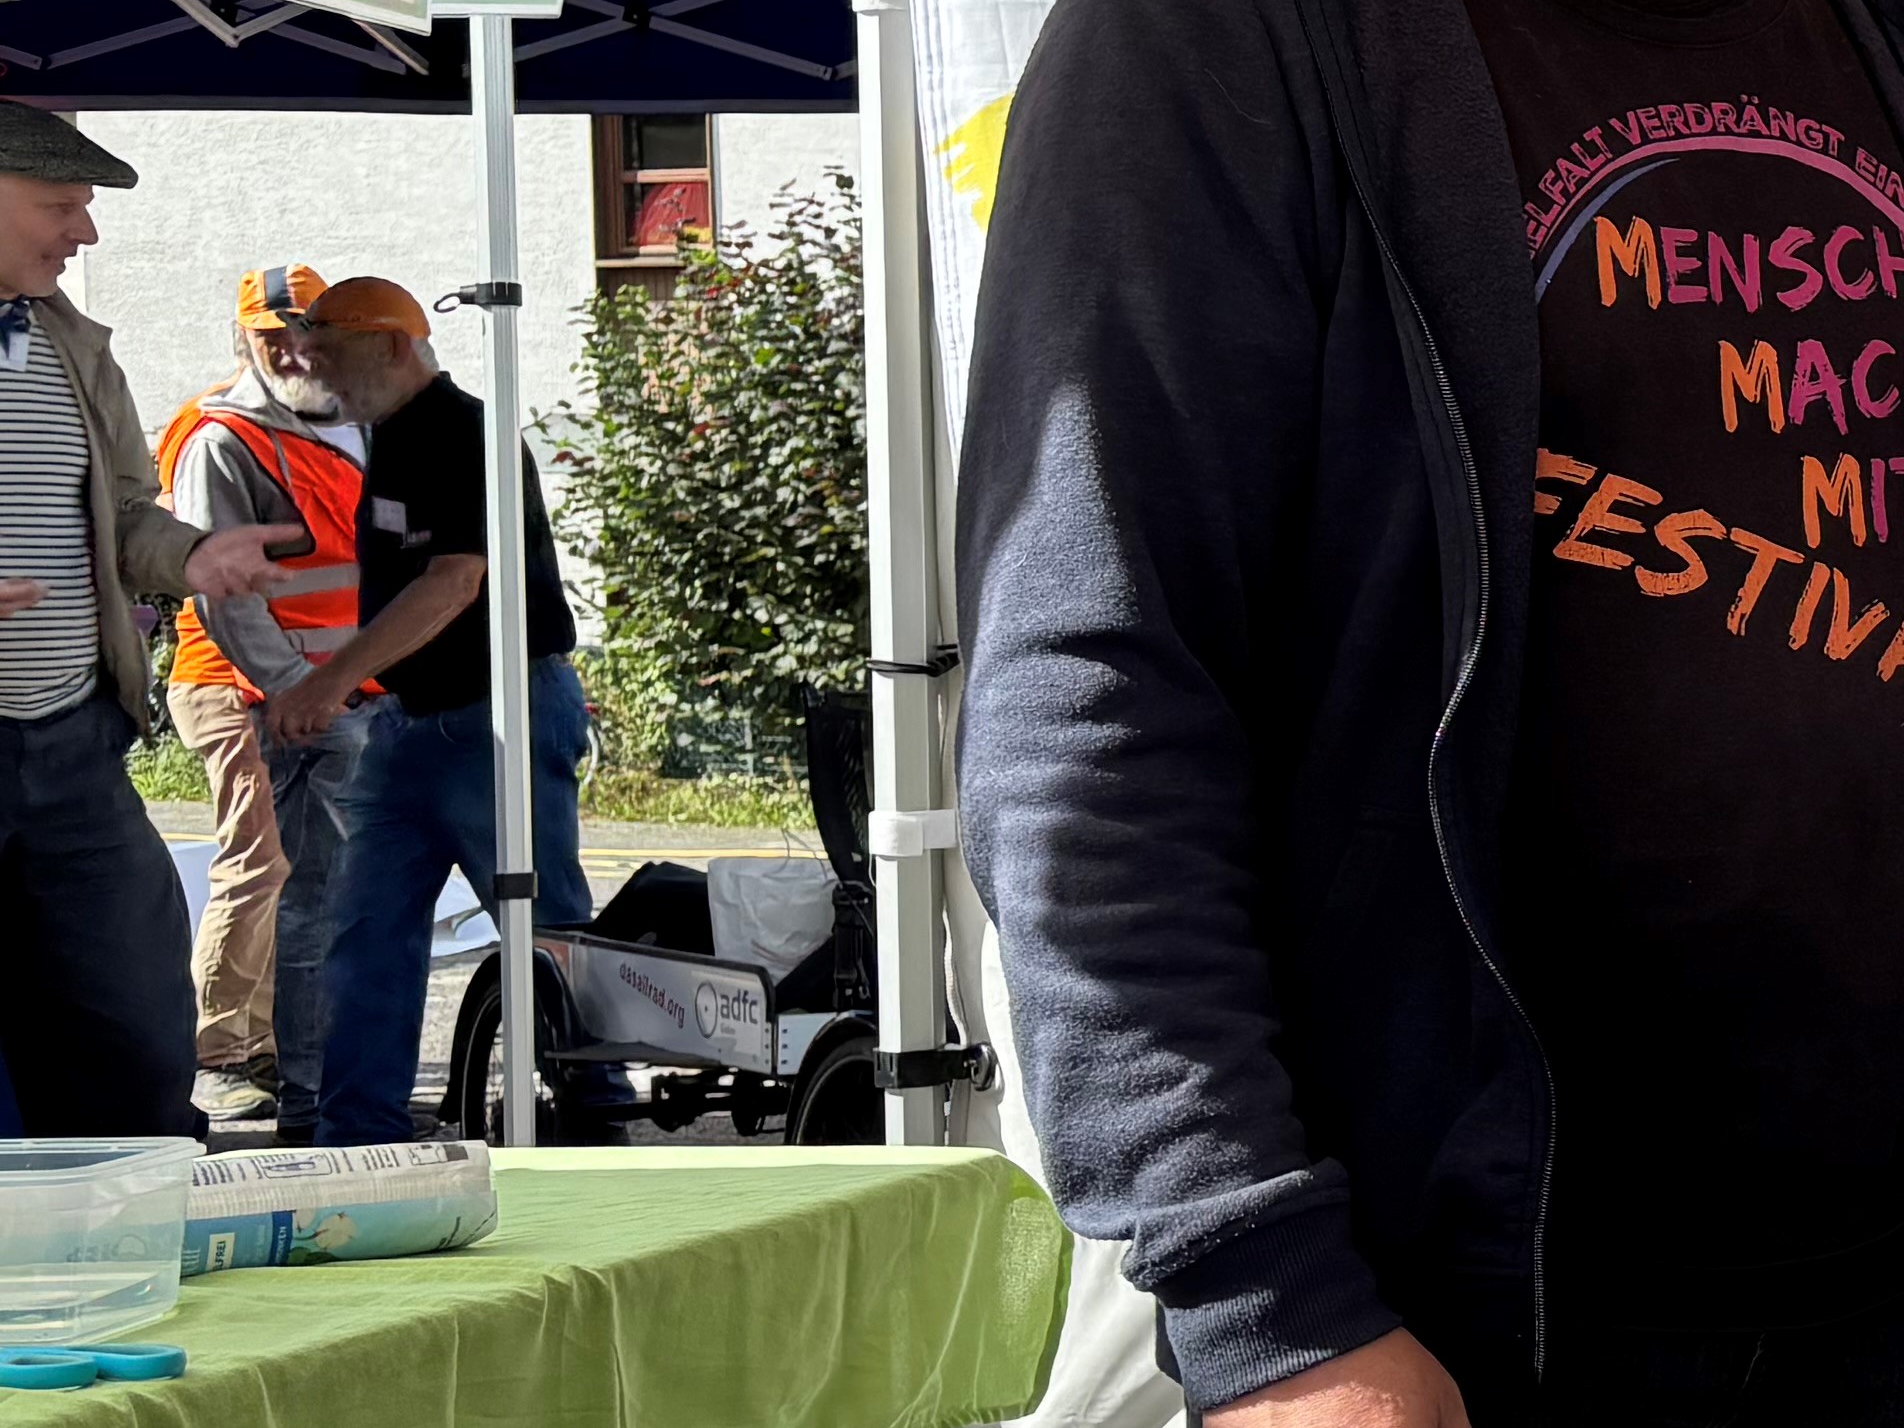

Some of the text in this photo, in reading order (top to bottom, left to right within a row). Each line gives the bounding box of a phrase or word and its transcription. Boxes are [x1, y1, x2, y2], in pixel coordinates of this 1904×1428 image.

[1524, 125, 1614, 260] ELFALT
[1607, 93, 1846, 166] VERDRÄNGT
[719, 988, 759, 1025] adfc
